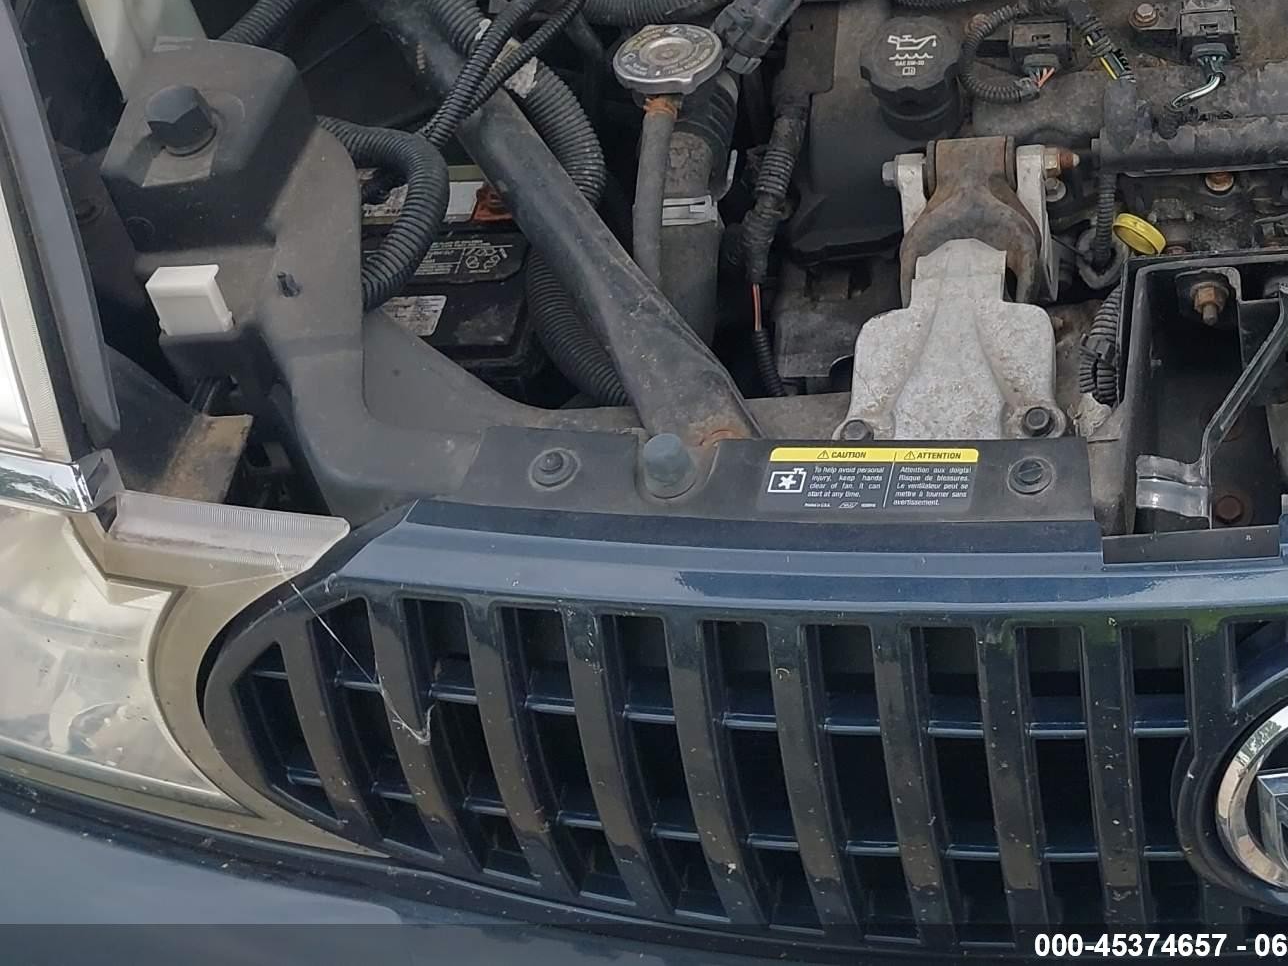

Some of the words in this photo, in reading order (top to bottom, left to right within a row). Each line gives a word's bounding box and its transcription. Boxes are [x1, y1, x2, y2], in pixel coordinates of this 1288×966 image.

[831, 451, 867, 459] CAUTION
[823, 466, 837, 474] help
[857, 466, 885, 474] personal
[898, 474, 921, 482] Risque
[831, 491, 844, 499] any
